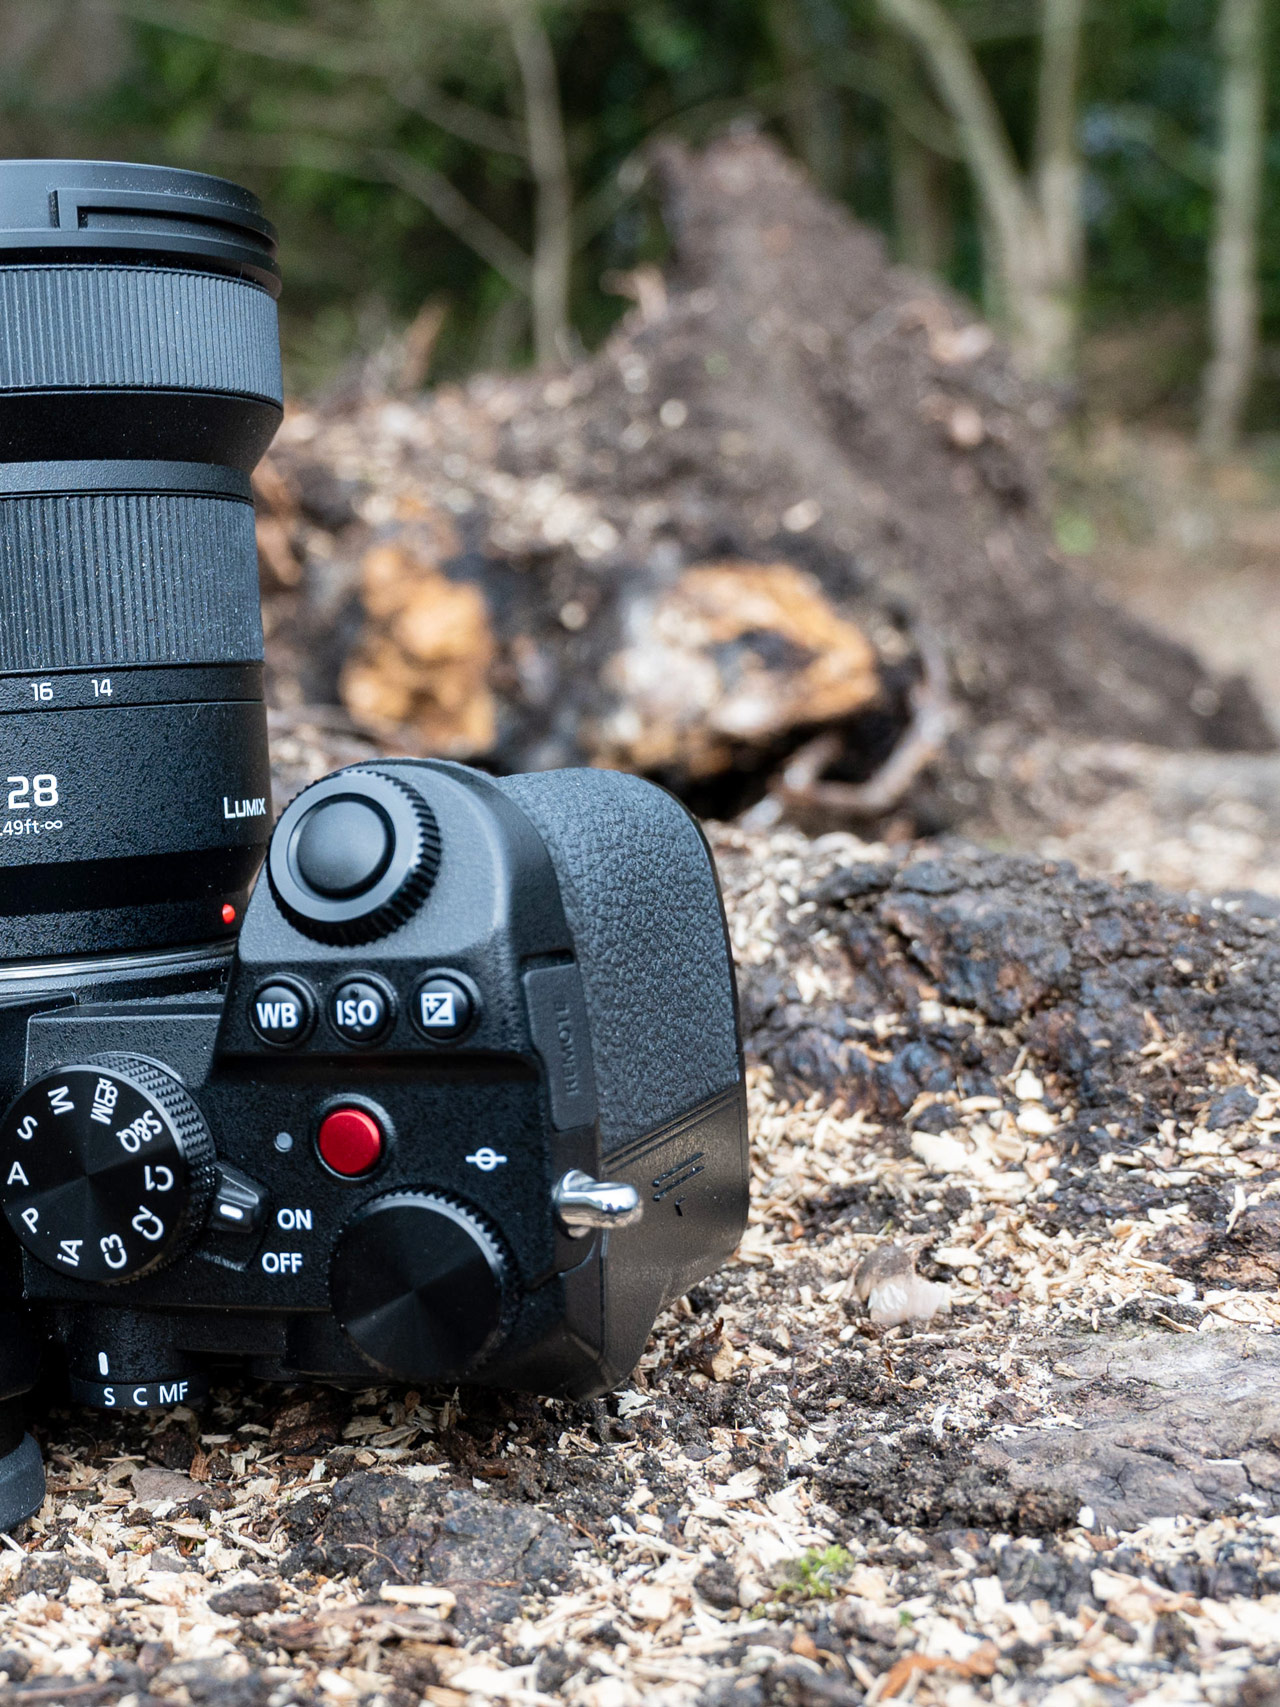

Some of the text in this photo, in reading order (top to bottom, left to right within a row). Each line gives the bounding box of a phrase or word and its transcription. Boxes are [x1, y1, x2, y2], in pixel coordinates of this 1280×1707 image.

[31, 682, 54, 702] 16
[91, 678, 113, 698] 14
[223, 796, 266, 819] LUMIX
[256, 1003, 299, 1028] WB
[336, 999, 378, 1026] ISO
[48, 1085, 75, 1115] M
[17, 1115, 38, 1140] S
[116, 1109, 163, 1153] S&Q
[6, 1161, 29, 1186] A
[144, 1165, 173, 1192] C1
[21, 1207, 38, 1233] P
[131, 1205, 164, 1241] C2
[277, 1208, 312, 1230] ON
[56, 1239, 83, 1266] iA
[99, 1233, 127, 1269] C3
[261, 1252, 303, 1274] OFF
[104, 1381, 188, 1406] S C MF
